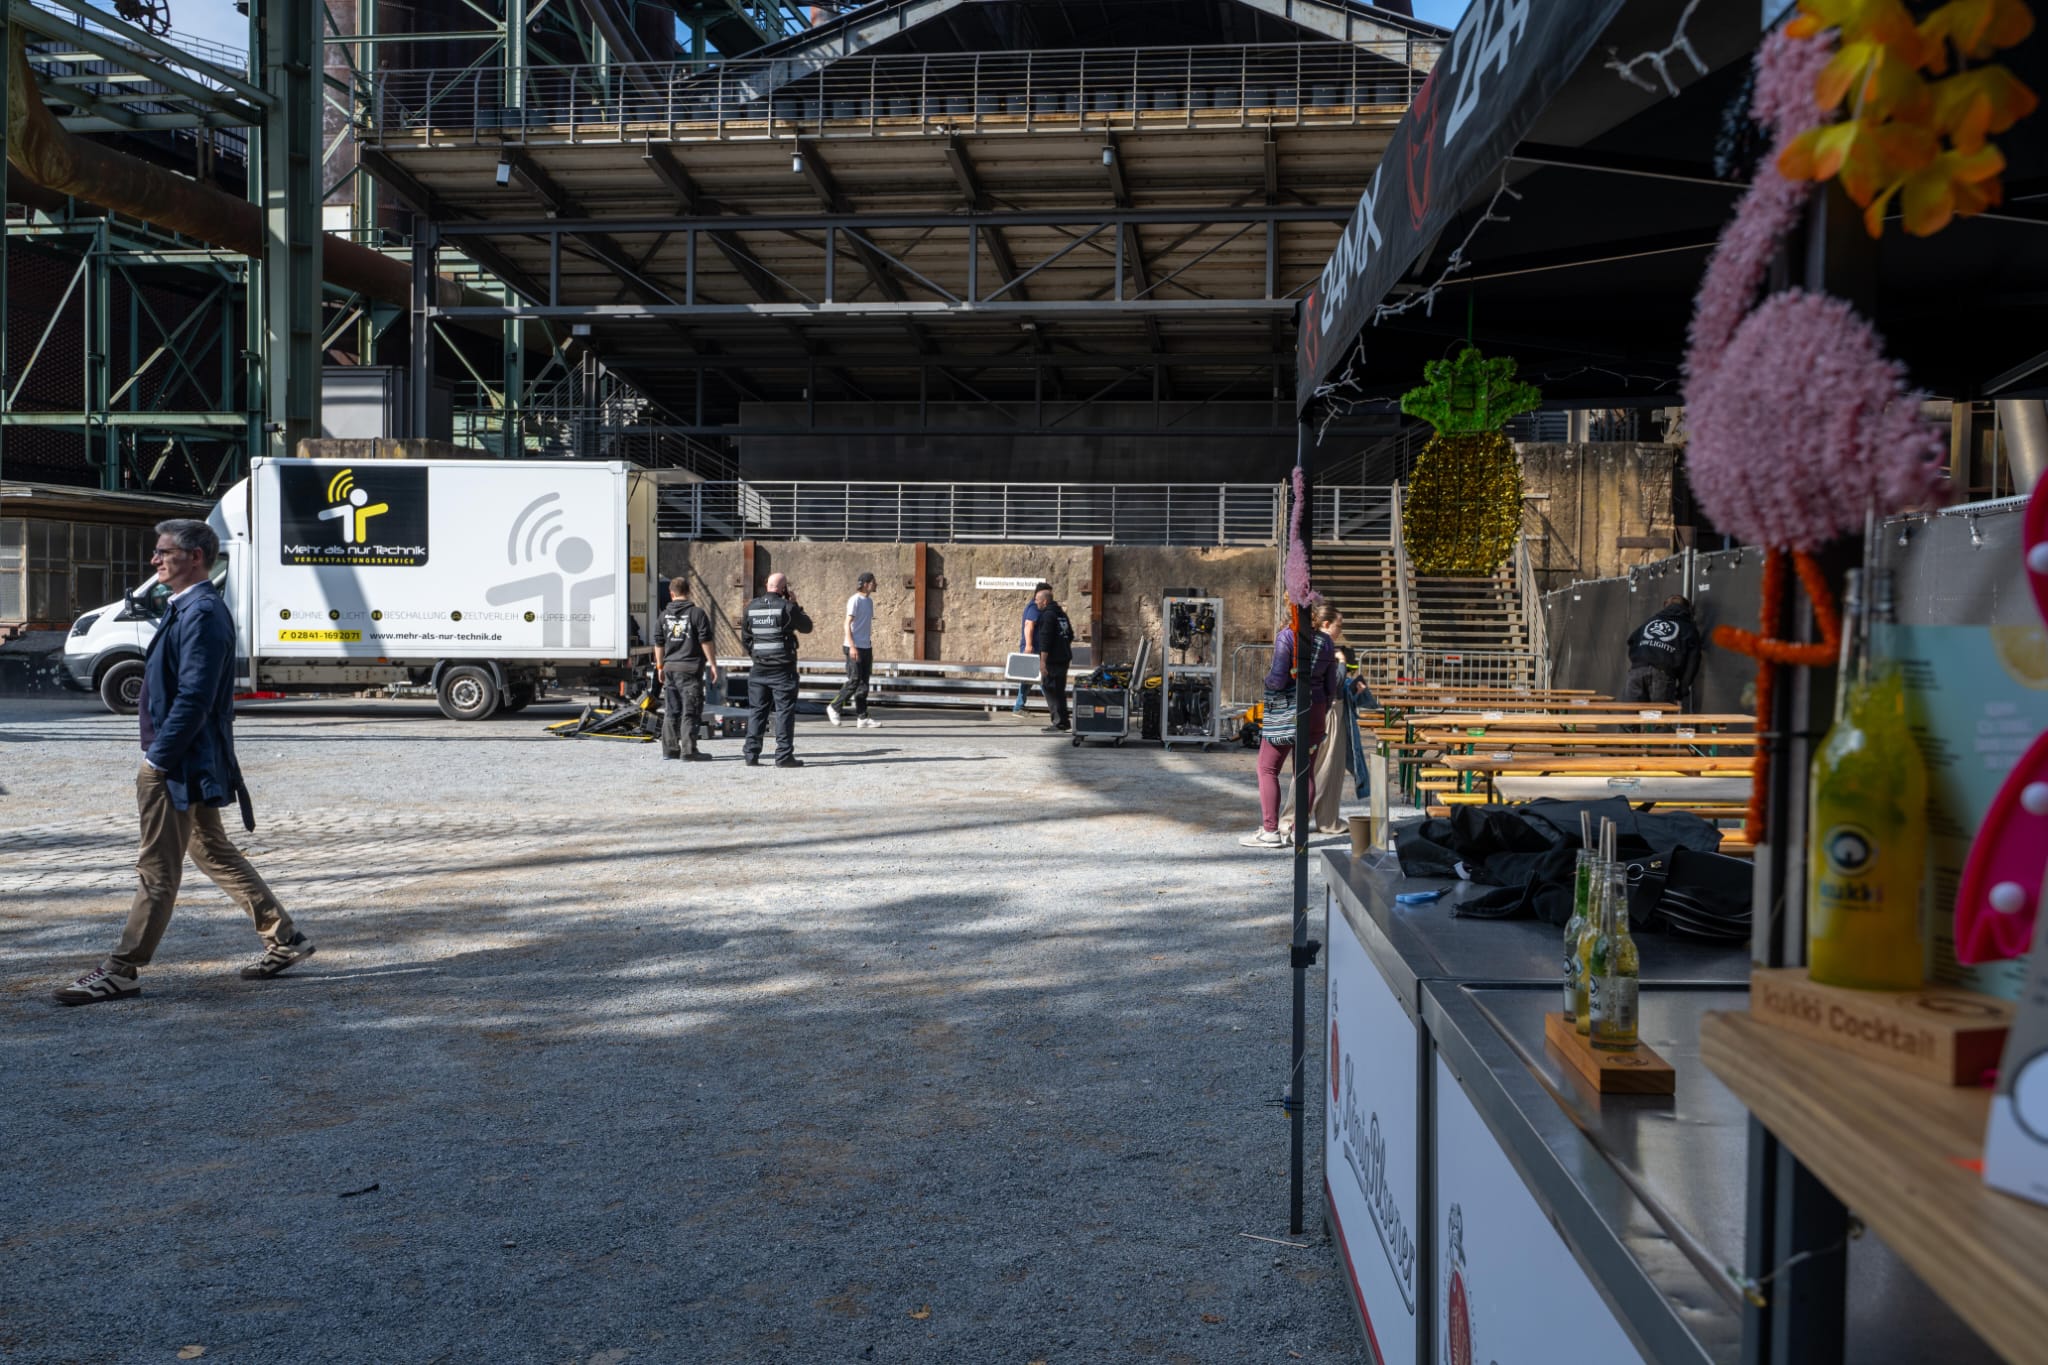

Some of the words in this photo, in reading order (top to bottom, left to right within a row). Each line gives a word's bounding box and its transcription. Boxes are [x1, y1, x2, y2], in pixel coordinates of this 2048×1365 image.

[1443, 0, 1531, 149] 24
[1320, 165, 1382, 337] 24MX
[284, 544, 321, 555] Mehr
[324, 545, 345, 555] als
[347, 545, 371, 555] nur
[373, 545, 426, 556] Technik
[294, 556, 415, 564] VERANSTALTUNGSSERVICE
[292, 609, 323, 619] BÜHNE
[341, 610, 366, 620] LICHT
[384, 611, 447, 620] BESCHALLUNG
[463, 611, 519, 621] ZELTVERLEIH
[536, 612, 596, 622] HÜPFBURGEN
[752, 615, 775, 626] Security
[369, 632, 503, 641] www.mehr-als-nur-technik.de
